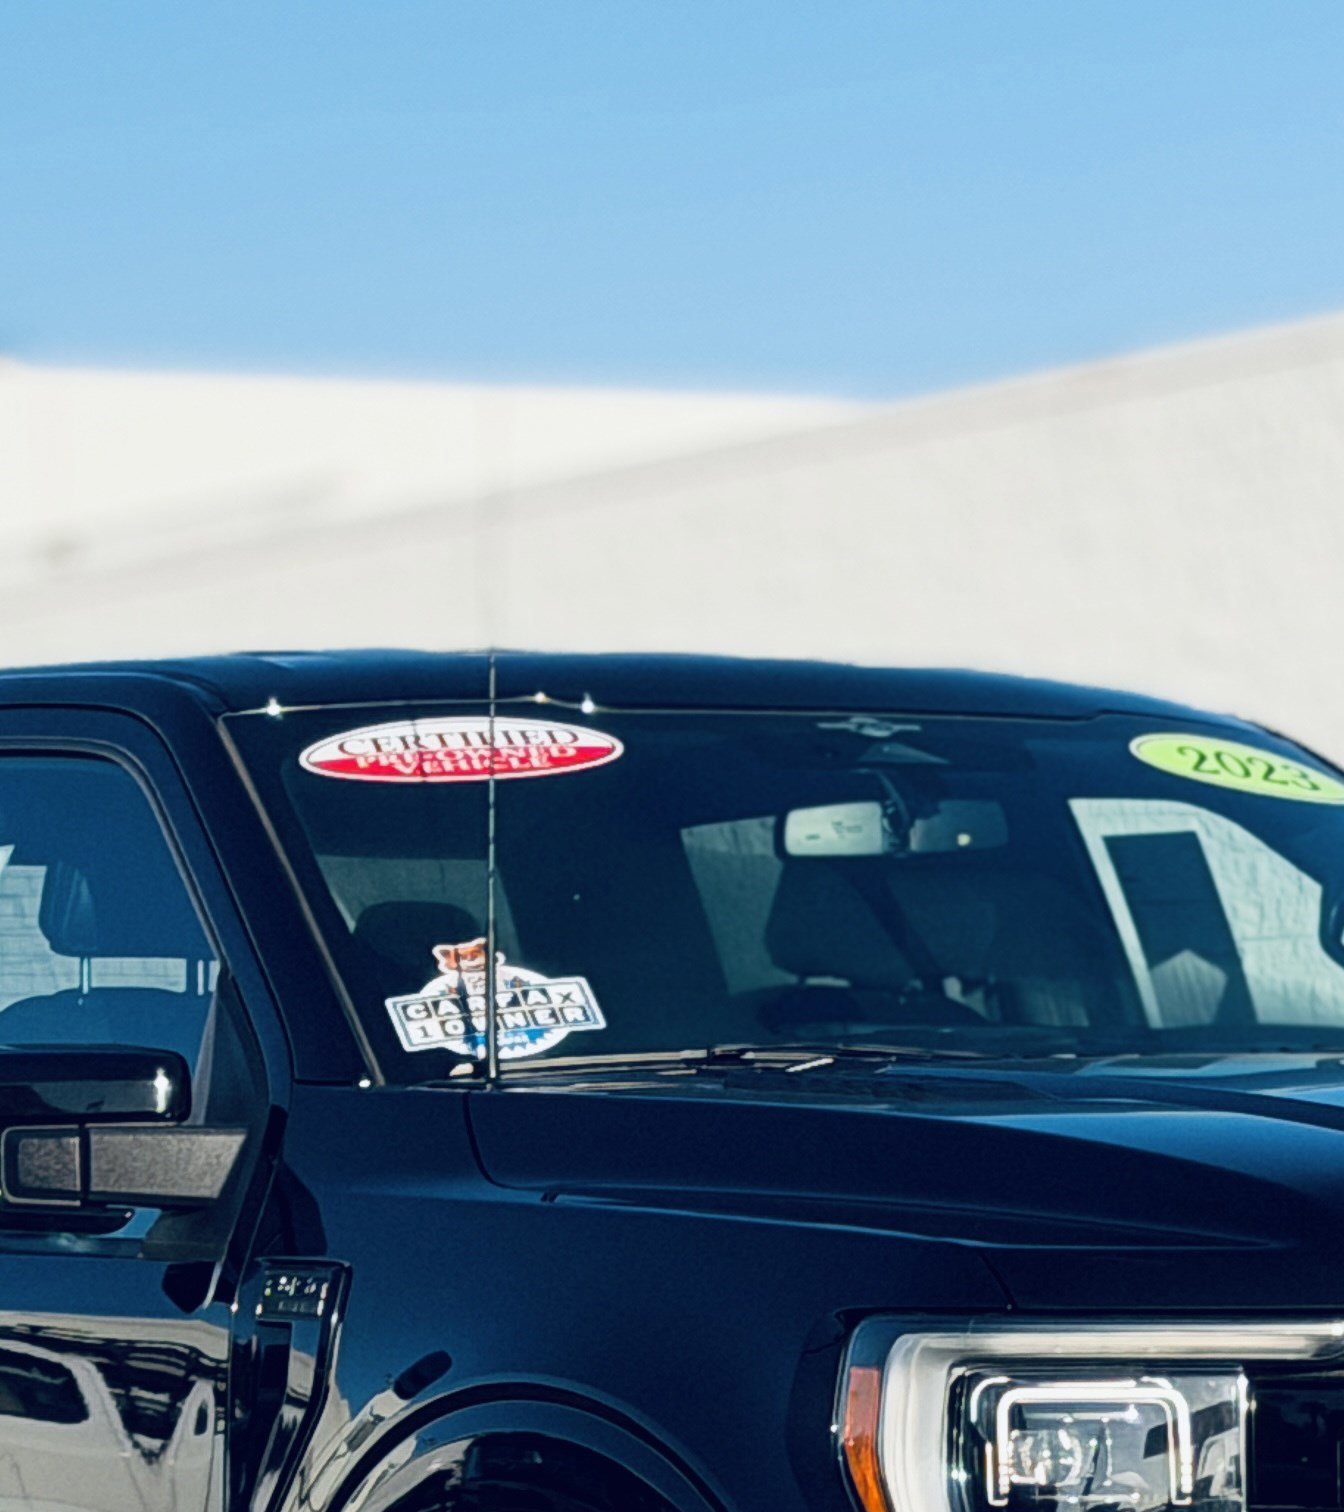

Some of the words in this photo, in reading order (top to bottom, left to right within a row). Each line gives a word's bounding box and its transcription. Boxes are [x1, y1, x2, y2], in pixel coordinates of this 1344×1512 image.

[336, 728, 581, 757] CERTIFIED
[1176, 743, 1321, 792] 2023
[404, 989, 574, 1020] CARFAX
